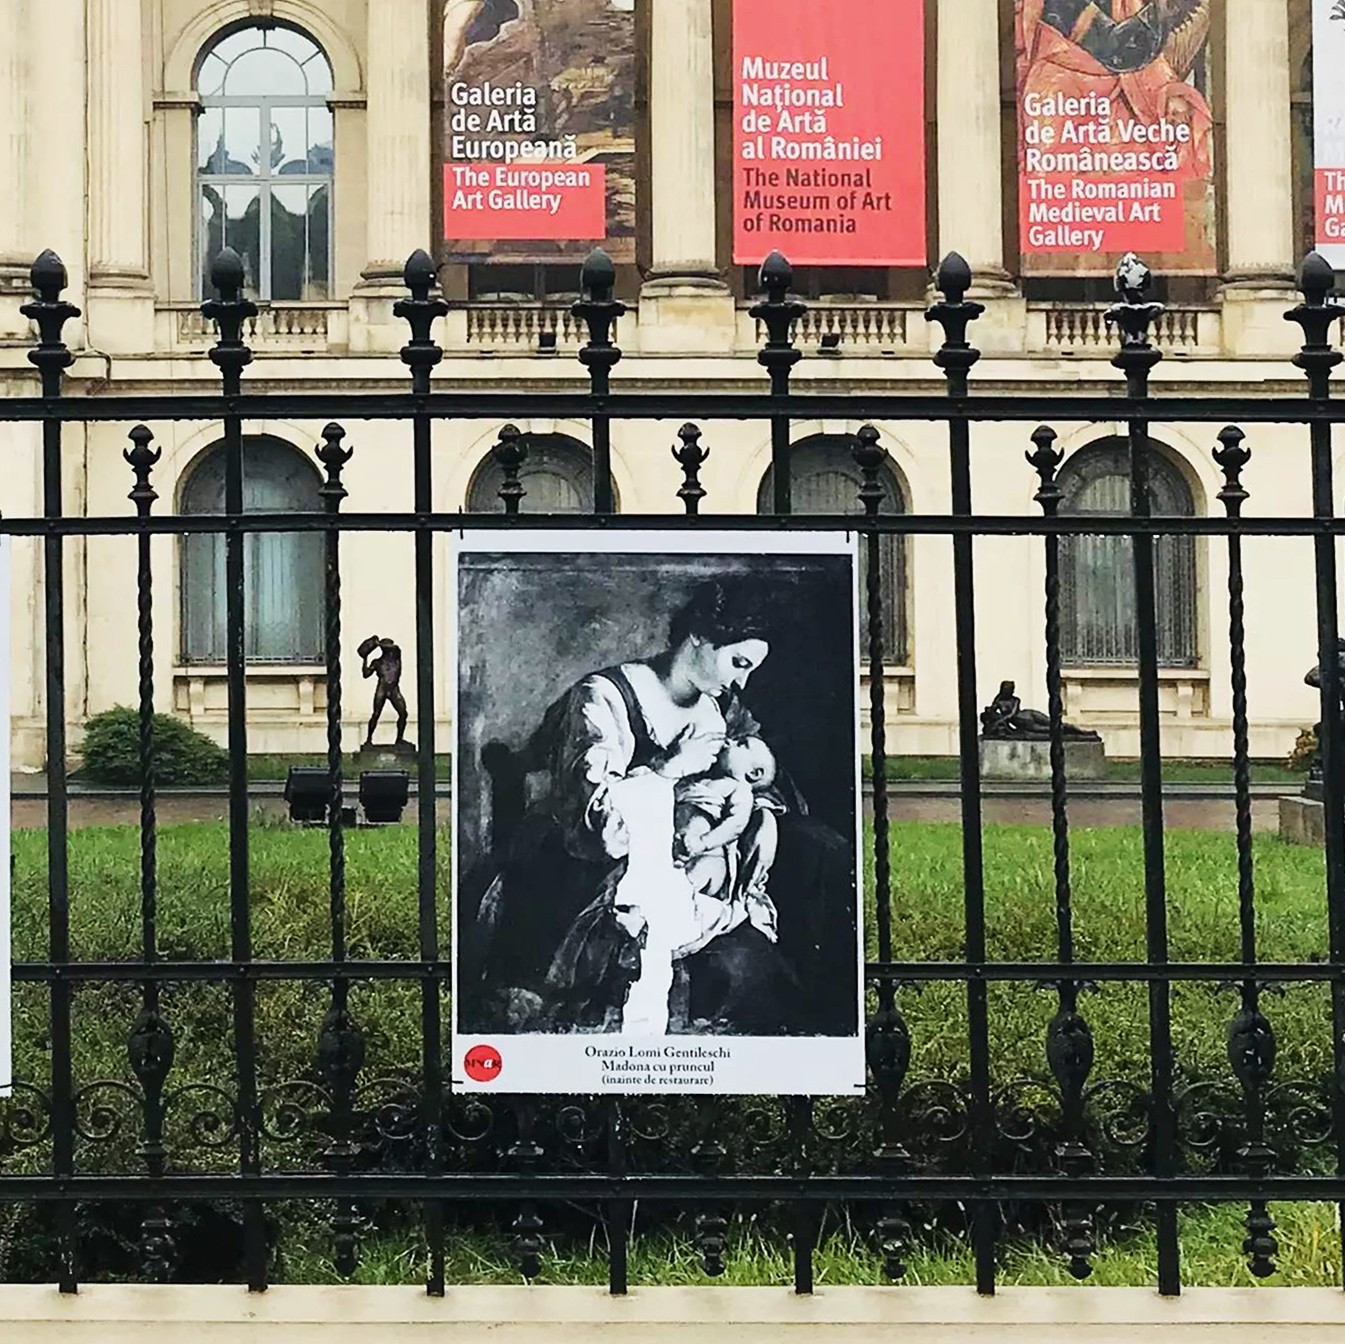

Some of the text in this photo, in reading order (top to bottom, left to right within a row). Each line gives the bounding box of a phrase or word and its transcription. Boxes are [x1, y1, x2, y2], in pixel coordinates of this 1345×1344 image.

[742, 56, 828, 80] Muzeul
[451, 82, 536, 105] Galeria
[1024, 91, 1110, 116] Galeria
[451, 107, 536, 131] de Artă
[742, 108, 826, 133] de Artă
[1025, 118, 1190, 144] de Artă Veche
[452, 134, 576, 164] Europeană
[742, 136, 882, 160] al României
[1026, 145, 1178, 171] Românească
[452, 167, 590, 191] The European
[743, 167, 871, 188] The National
[1027, 178, 1175, 199] The Romanian
[452, 190, 561, 214] Art Gallery
[743, 191, 892, 211] Museum of Art
[1029, 201, 1161, 222] Medieval Art
[743, 213, 856, 233] of Romania
[1029, 225, 1104, 251] Gallery
[584, 1046, 731, 1058] Orazio Lomi Gentileschi
[601, 1060, 715, 1075] Madona cu pruncul
[644, 1074, 656, 1084] de
[659, 1075, 714, 1086] restaurare)
